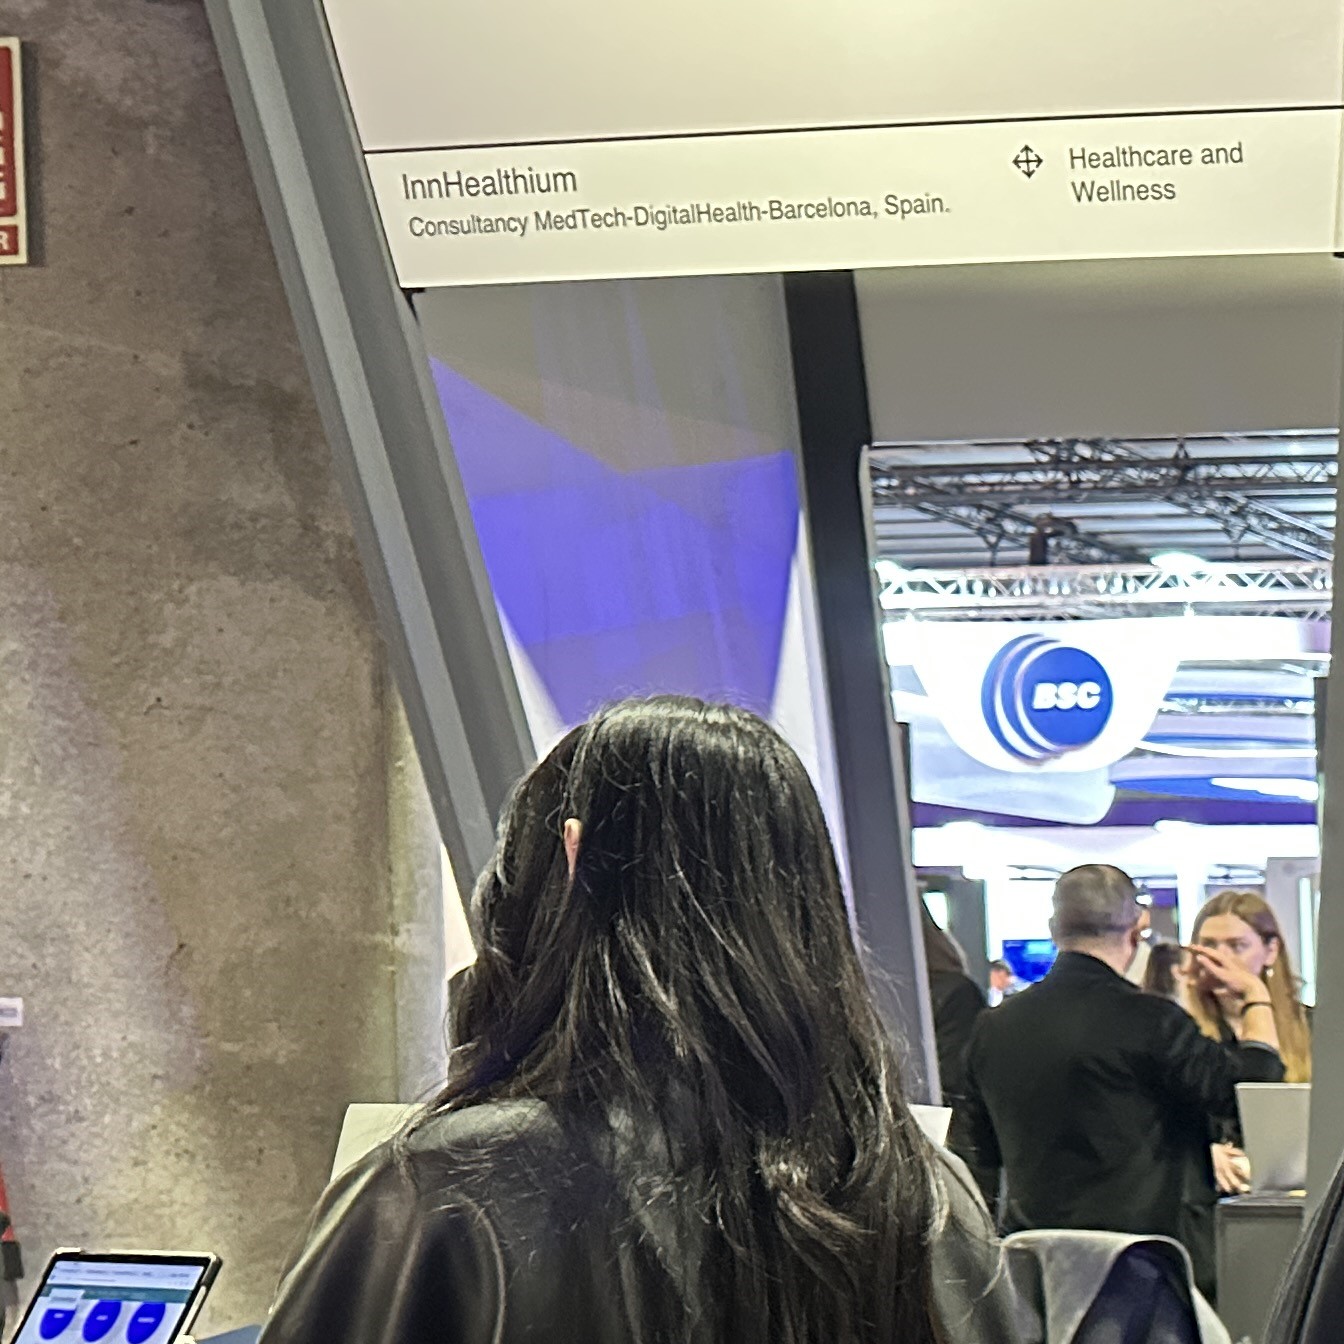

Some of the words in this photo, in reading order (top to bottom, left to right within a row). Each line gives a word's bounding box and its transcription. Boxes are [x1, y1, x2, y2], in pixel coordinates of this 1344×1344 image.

[1069, 144, 1193, 170] Healthcare
[1201, 142, 1244, 165] and
[402, 167, 577, 201] InnHealthium
[1071, 179, 1176, 203] Wellness
[409, 211, 529, 239] Consultancy
[534, 196, 878, 233] MedTech-DigitalHealth-Barcelona,
[884, 193, 951, 219] Spain.
[1032, 681, 1101, 710] BSC
